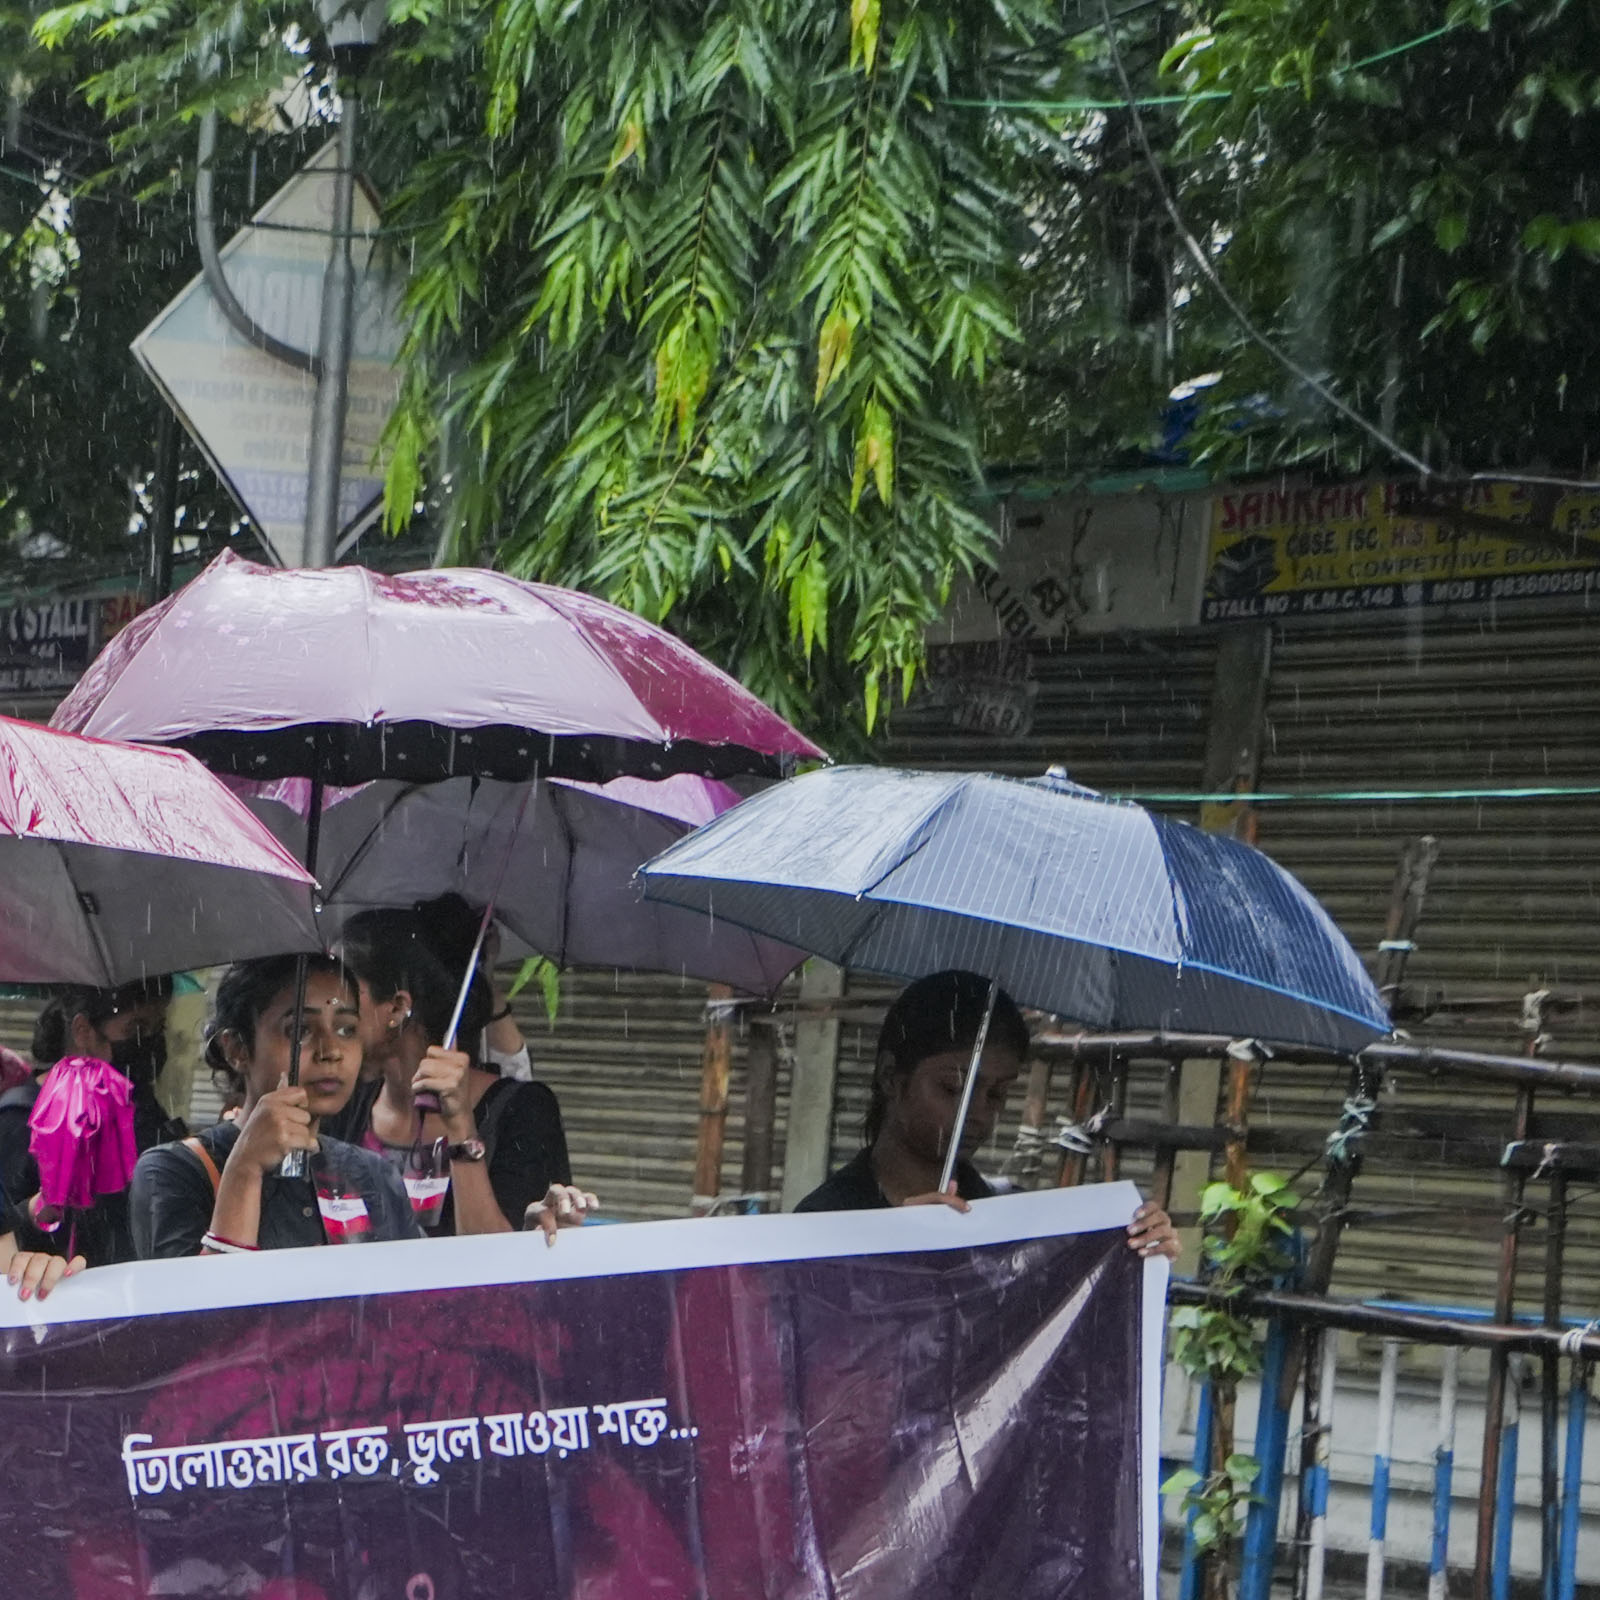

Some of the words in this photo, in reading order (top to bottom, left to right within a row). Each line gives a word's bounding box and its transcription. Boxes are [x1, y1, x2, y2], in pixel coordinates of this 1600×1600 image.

[122, 1434, 317, 1496] তিলোত্তমার
[404, 1417, 479, 1485] ভুলে
[485, 1406, 588, 1461] যাওয়া
